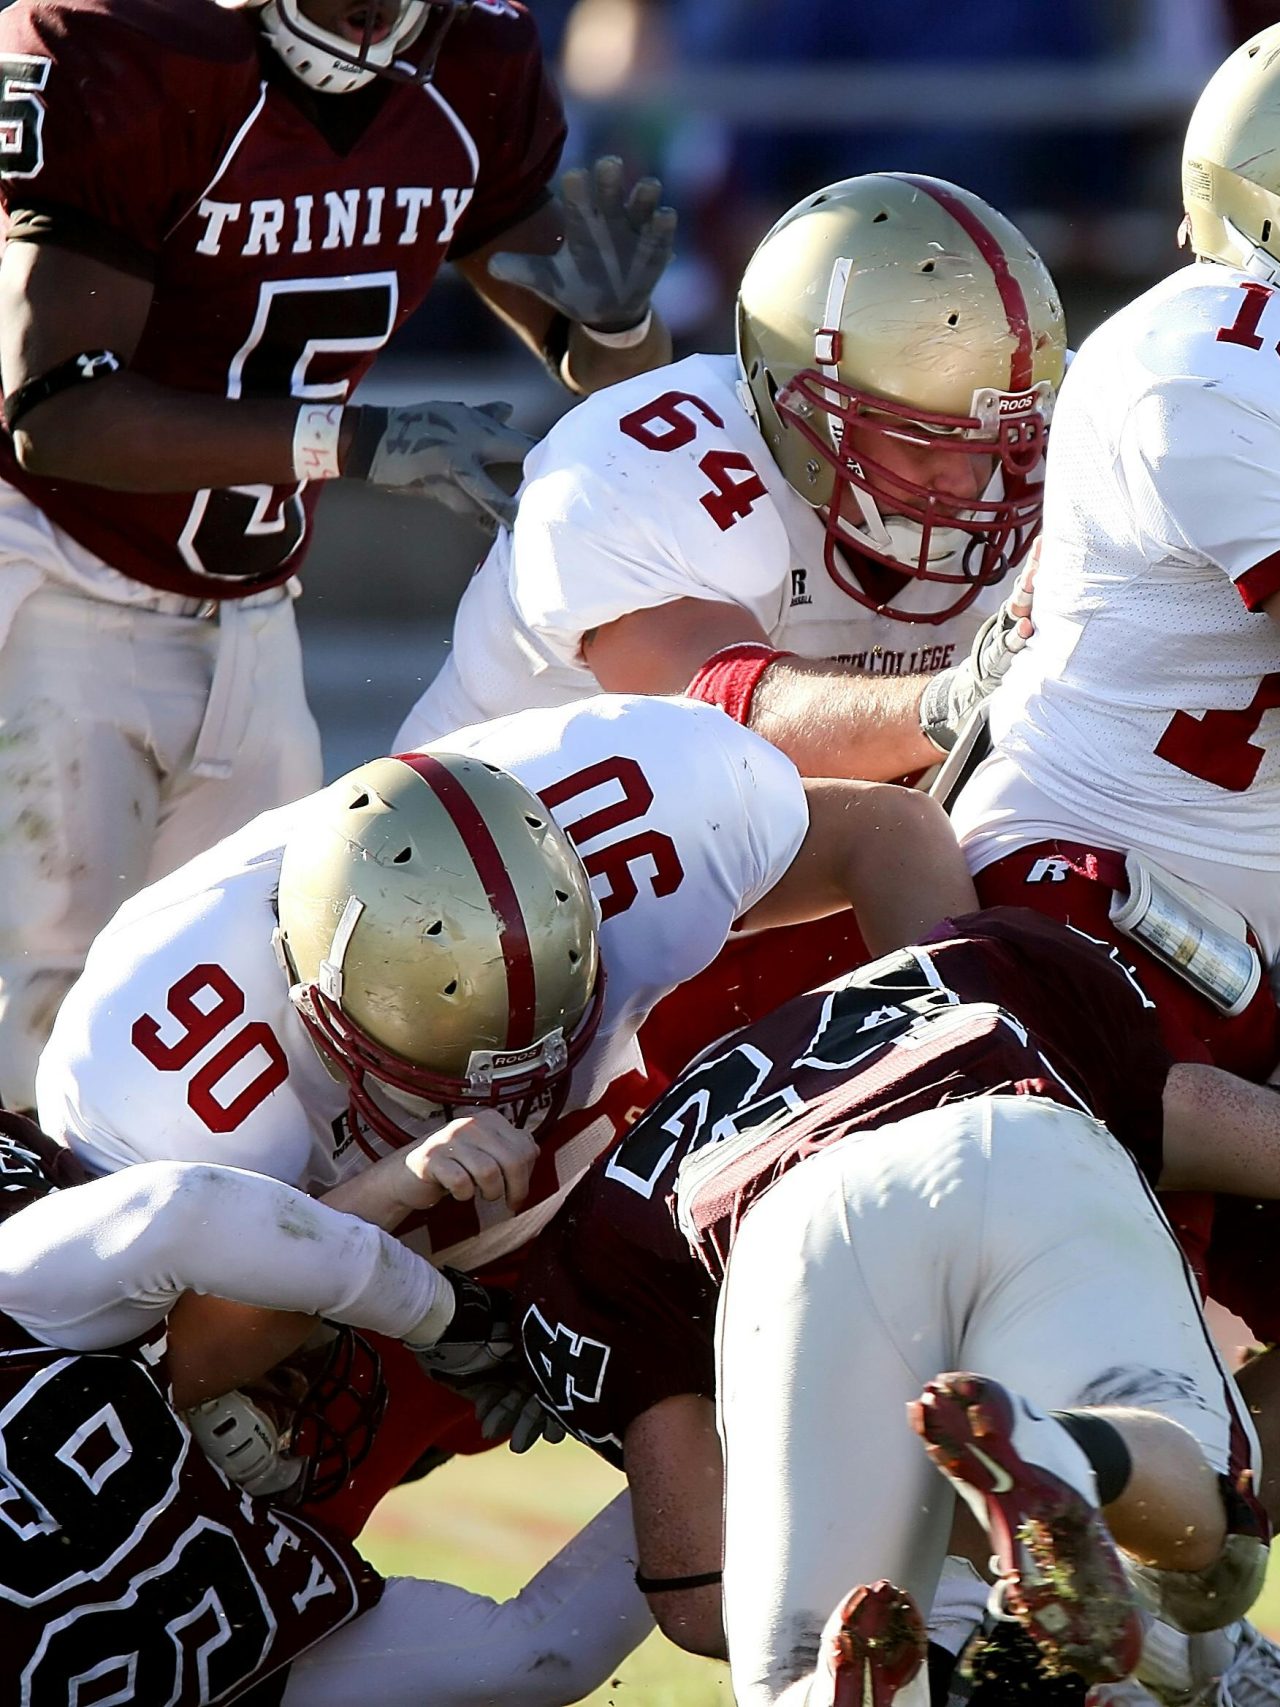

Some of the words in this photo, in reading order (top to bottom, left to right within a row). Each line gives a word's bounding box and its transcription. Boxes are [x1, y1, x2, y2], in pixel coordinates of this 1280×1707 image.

[195, 186, 475, 257] TRINITY
[1000, 396, 1034, 411] ROOS
[620, 391, 769, 532] 64
[131, 963, 289, 1134] 90
[494, 1049, 538, 1066] ROOS
